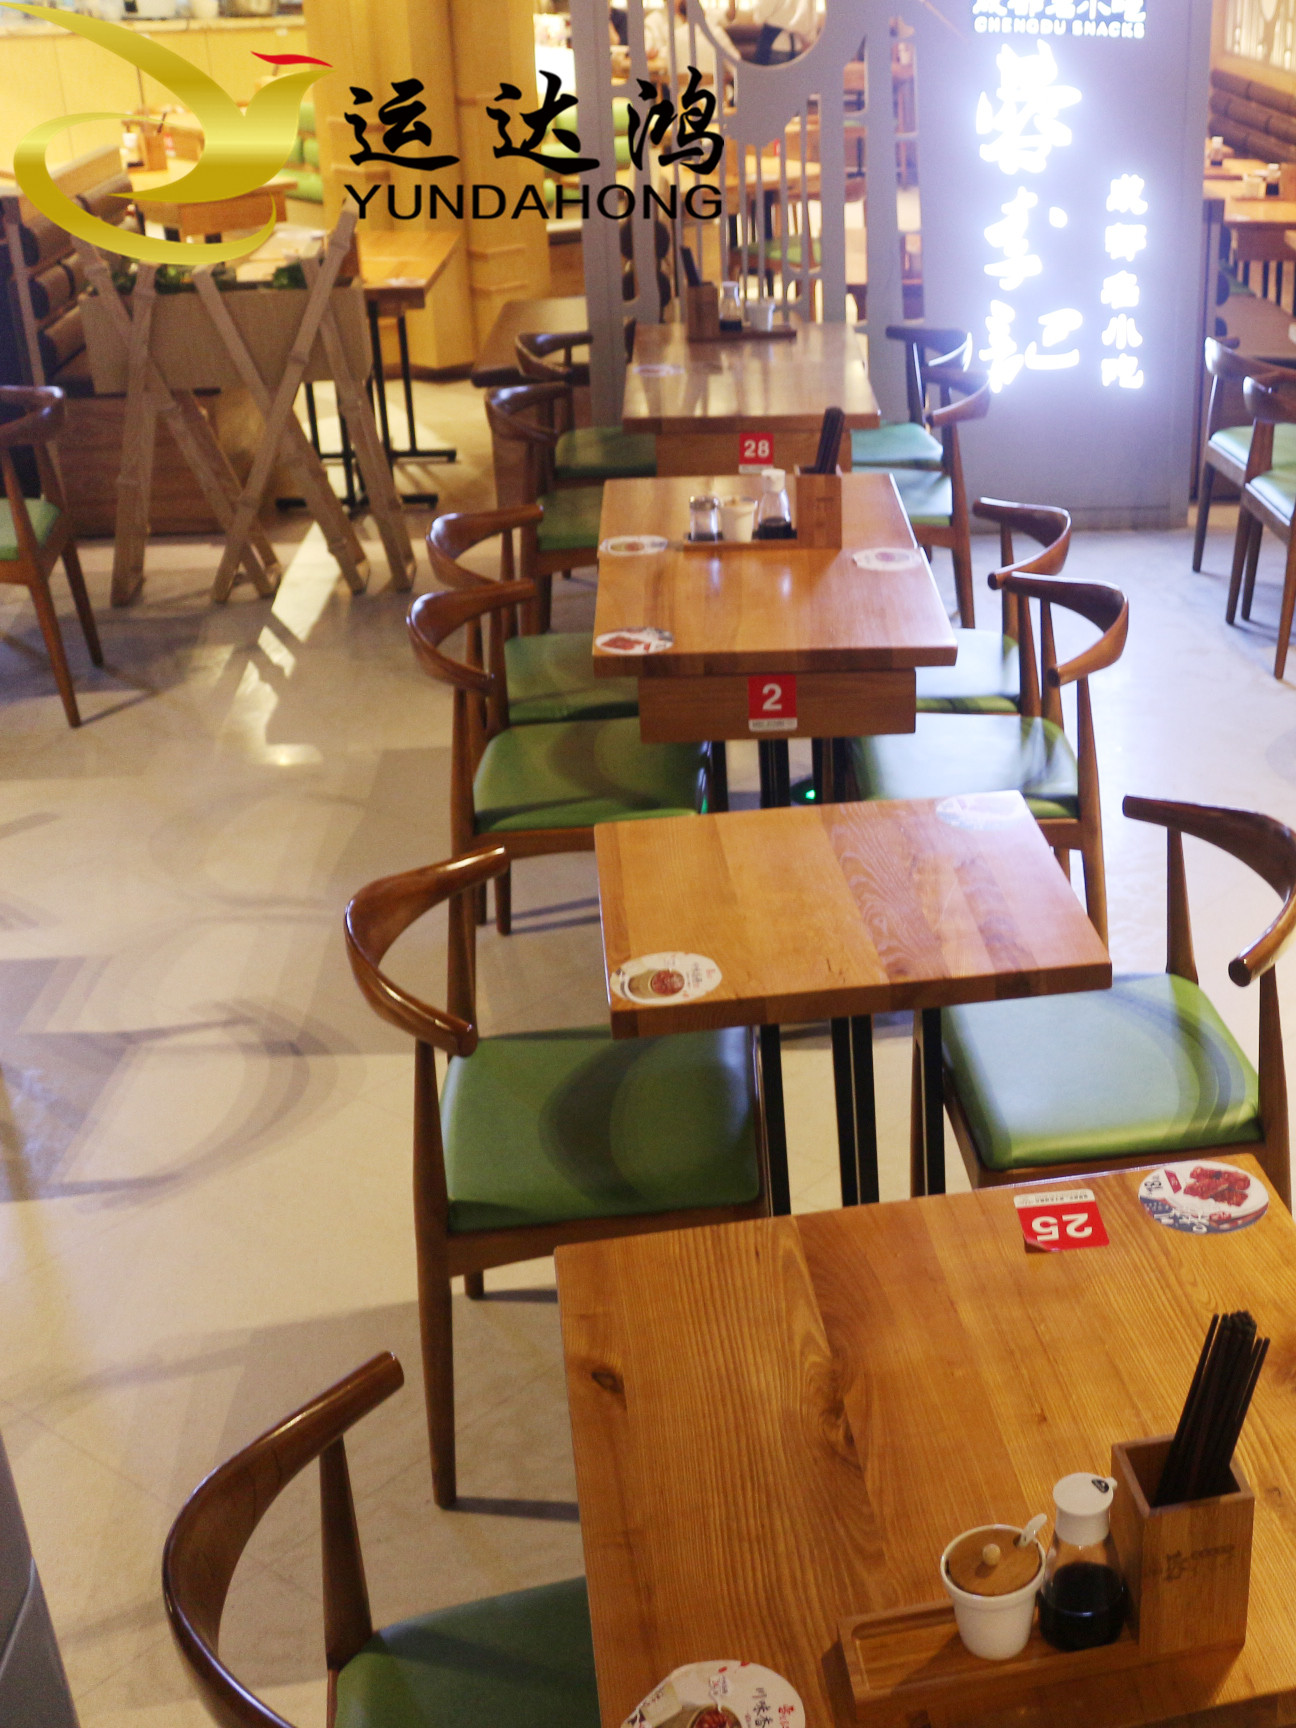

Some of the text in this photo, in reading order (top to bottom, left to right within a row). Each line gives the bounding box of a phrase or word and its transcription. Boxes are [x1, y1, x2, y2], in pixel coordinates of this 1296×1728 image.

[974, 16, 1145, 39] CHENGDU SNACKS
[743, 438, 770, 459] 28
[762, 682, 783, 712] 2
[1031, 1212, 1093, 1242] 25
